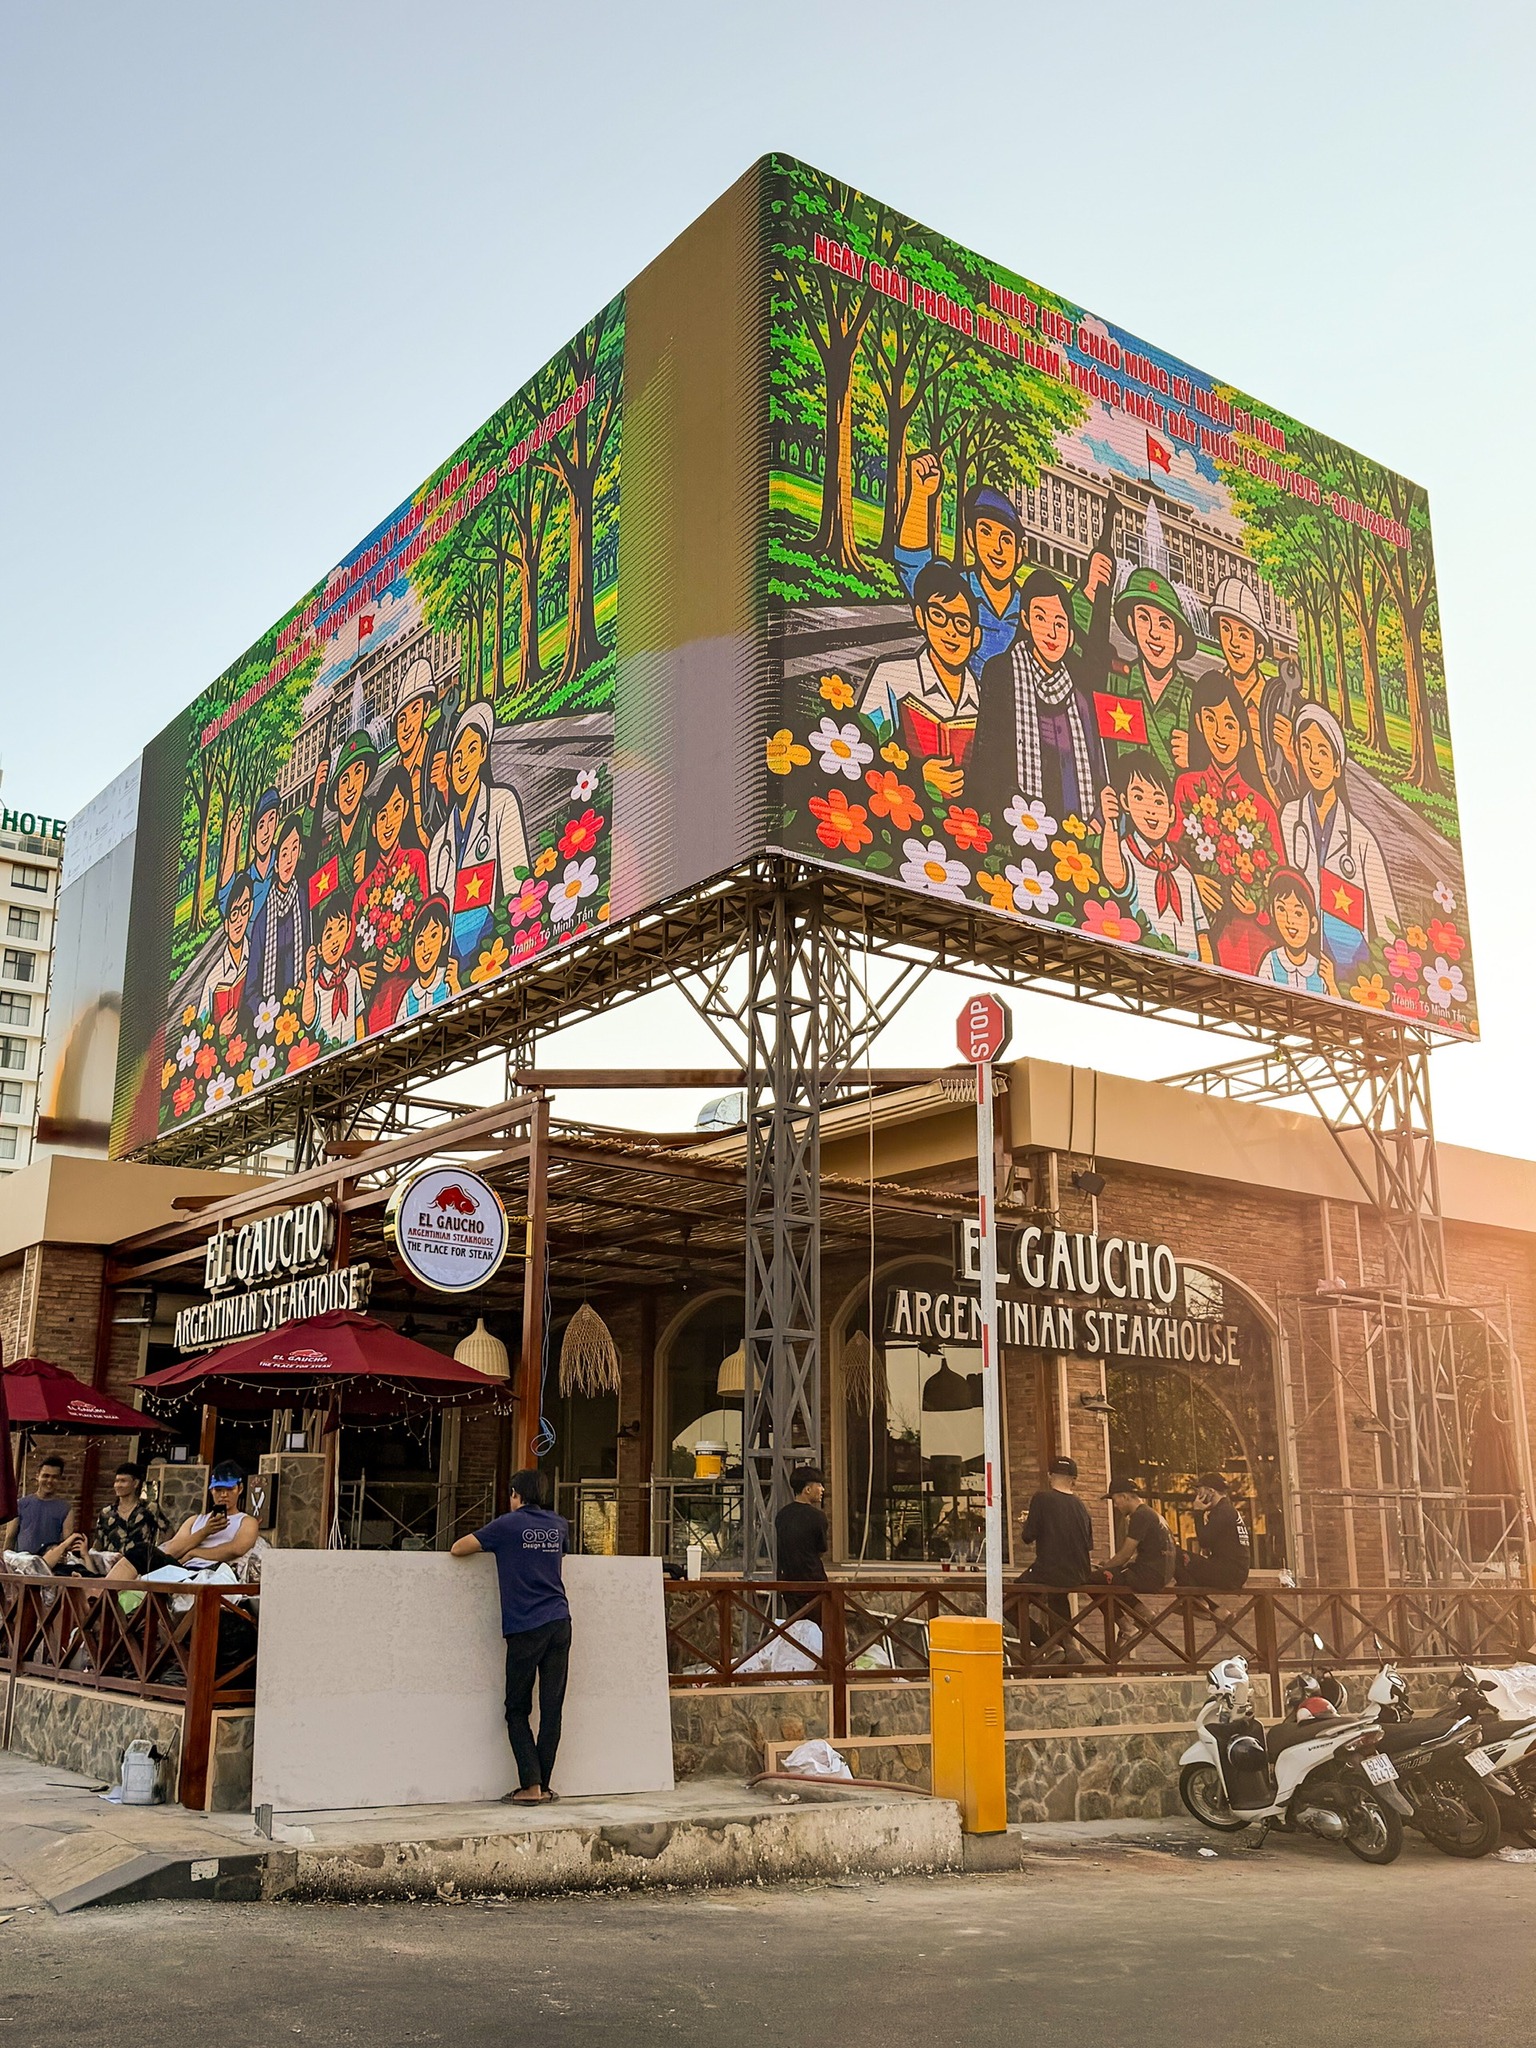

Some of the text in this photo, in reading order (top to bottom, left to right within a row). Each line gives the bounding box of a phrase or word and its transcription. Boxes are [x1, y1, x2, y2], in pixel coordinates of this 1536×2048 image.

[814, 232, 867, 282] NGÀY
[869, 261, 909, 305] GIẢI
[912, 281, 974, 336] PHÓNG
[976, 313, 1021, 360] MIỀN
[1023, 337, 1065, 384] NAM,
[1068, 359, 1122, 410] THỐNG
[1124, 387, 1165, 431] NHẤT
[1167, 407, 1198, 446] ĐẤT
[1200, 425, 1241, 467] NƯỚC
[1243, 447, 1322, 507] (30/4/1975
[1331, 491, 1413, 552] 30/4/2026)!
[989, 280, 1286, 454] NHIỆT LIỆT CHÀO MỪNG KỶ NIỆM 51 NĂM
[426, 485, 440, 516] 51
[2, 808, 67, 841] HOTE
[970, 1000, 990, 1058] STOP
[204, 1199, 324, 1289] EL GAUCHO
[407, 1227, 495, 1247] ARGENTINIAN STEAKHOUSE
[407, 1241, 494, 1261] THE PLACE FOR STEAK
[418, 1212, 485, 1234] EL GAUCHO
[1019, 1226, 1177, 1304] GAUCHO
[173, 1266, 360, 1349] ARGENTINIAN STEAKHOUSE
[894, 1289, 1242, 1367] ARGENINIAN STEAKHOUSE
[288, 1355, 328, 1363] GAUCHO
